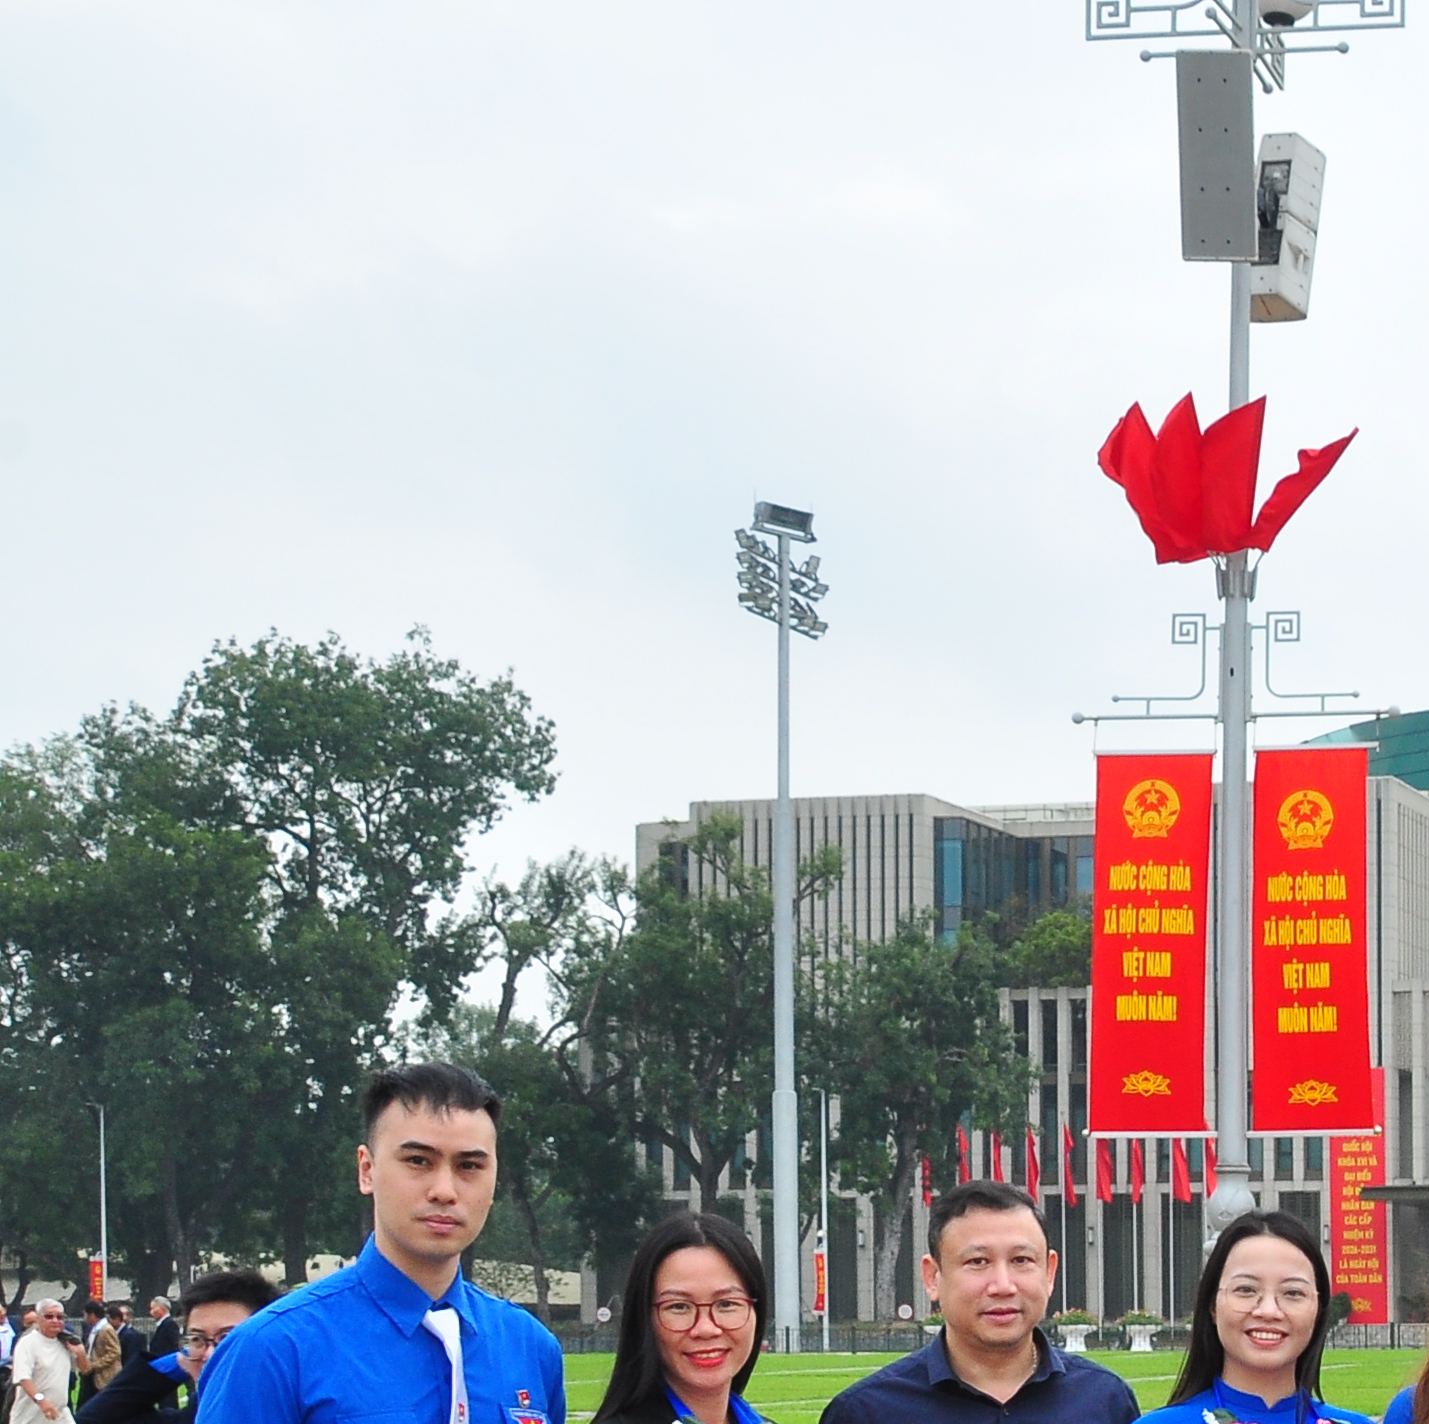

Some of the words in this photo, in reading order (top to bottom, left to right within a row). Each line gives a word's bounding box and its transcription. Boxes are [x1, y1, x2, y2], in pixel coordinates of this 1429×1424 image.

[1110, 860, 1137, 891] NƯỚC
[1140, 860, 1168, 896] CỘNG
[1170, 859, 1191, 891] HÒA
[1268, 871, 1293, 902] NƯỚC
[1296, 870, 1324, 907] CỘNG
[1326, 869, 1347, 901] HÒA
[1104, 904, 1118, 934] XÃ
[1120, 904, 1137, 939] HỘI
[1139, 900, 1160, 934] CHỦ
[1162, 904, 1195, 936] NGHĨA
[1264, 916, 1277, 946] XÃ
[1279, 915, 1294, 951] HỘI
[1297, 911, 1317, 946] CHỦ
[1320, 914, 1352, 945] NGHĨA
[1123, 947, 1145, 983] VIỆT
[1147, 952, 1171, 978] NAM
[1283, 958, 1304, 995] VIỆT
[1306, 963, 1330, 989] NAM
[1117, 990, 1147, 1021] MUÔN
[1149, 990, 1177, 1022] NĂM!
[1279, 1002, 1308, 1033] MUÔN
[1310, 1002, 1338, 1033] NĂM!
[1343, 1139, 1360, 1152] QUỐC
[1361, 1141, 1373, 1154] HỘI
[1345, 1214, 1358, 1226] CÁC
[1359, 1213, 1373, 1226] CẤP
[1336, 1273, 1349, 1284] CỦA
[1351, 1273, 1368, 1284] TOÀN
[1369, 1272, 1383, 1284] DÂN
[1340, 1258, 1349, 1269] LÀ
[1368, 1259, 1379, 1271] HỘI
